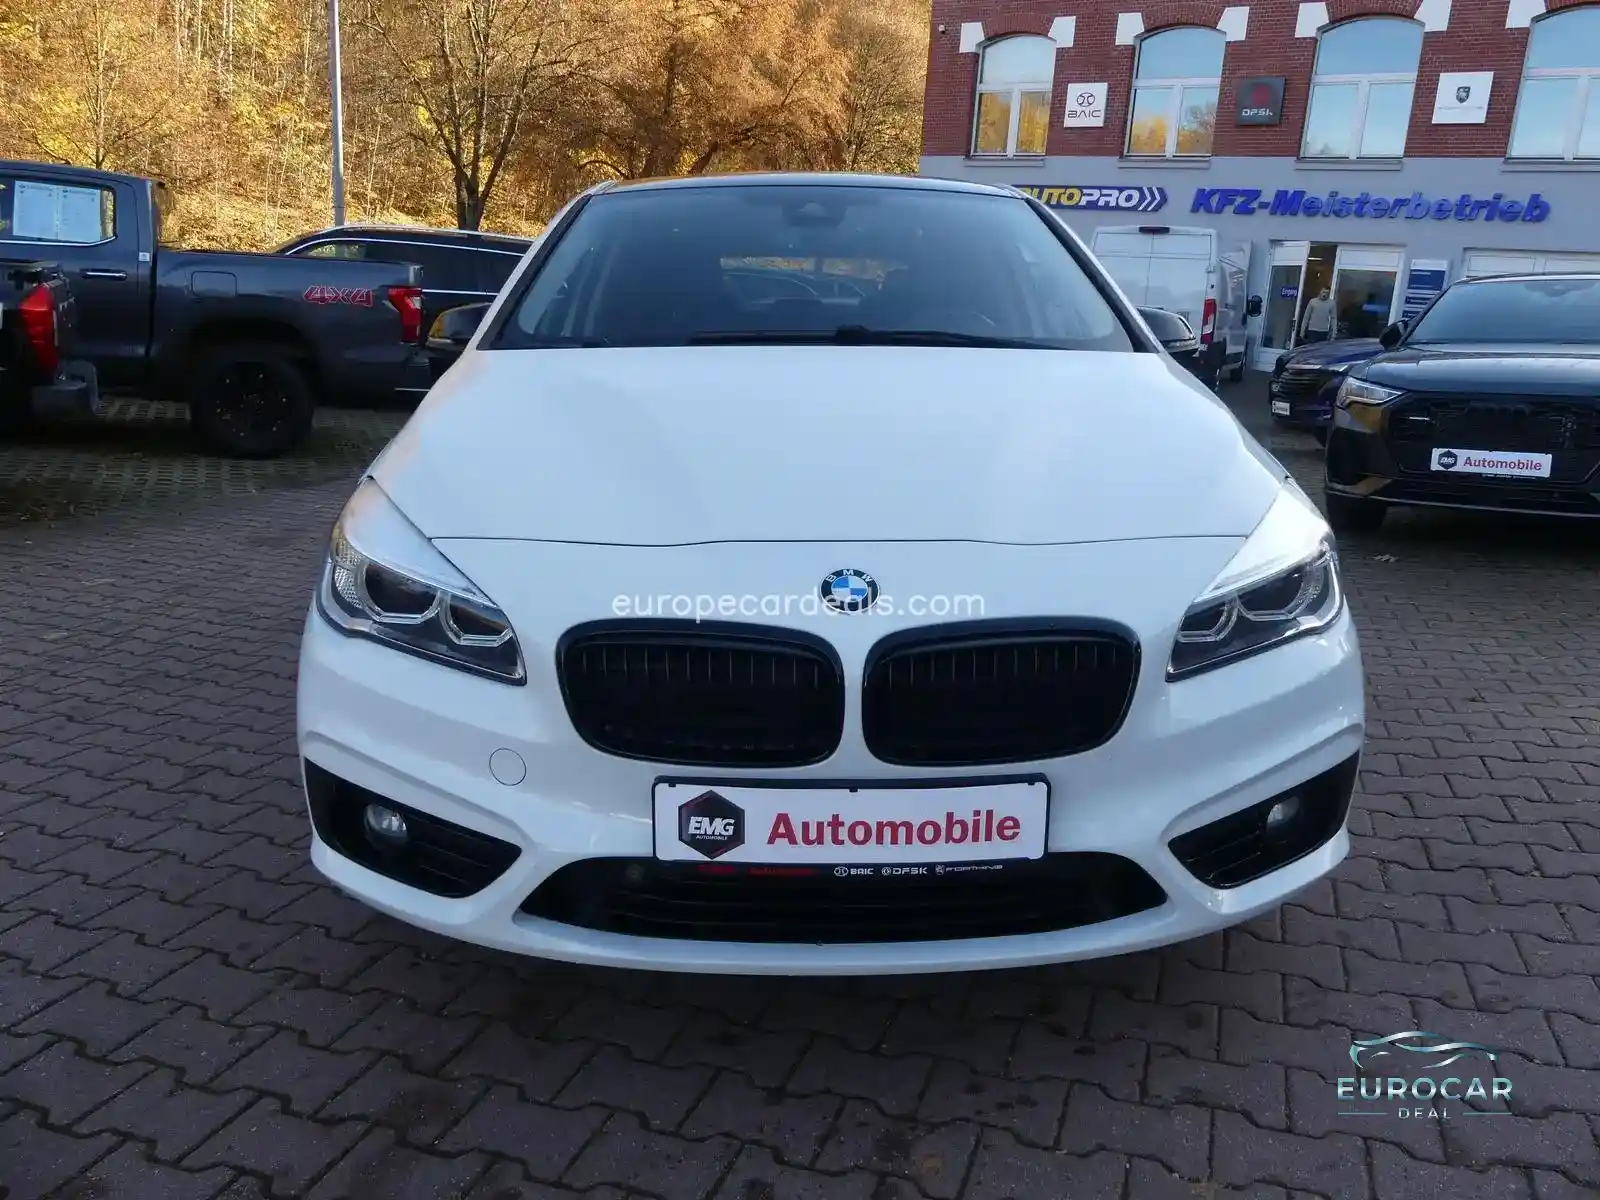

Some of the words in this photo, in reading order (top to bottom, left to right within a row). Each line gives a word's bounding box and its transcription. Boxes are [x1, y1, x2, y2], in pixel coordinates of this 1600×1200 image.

[1067, 109, 1102, 118] BAIC
[1190, 187, 1551, 223] KFZ-Meisterbetrieb
[1463, 456, 1543, 471] Automobile
[825, 569, 873, 583] BMW
[688, 816, 735, 836] EMG
[767, 810, 1021, 846] Automobile
[892, 866, 928, 875] DFSK
